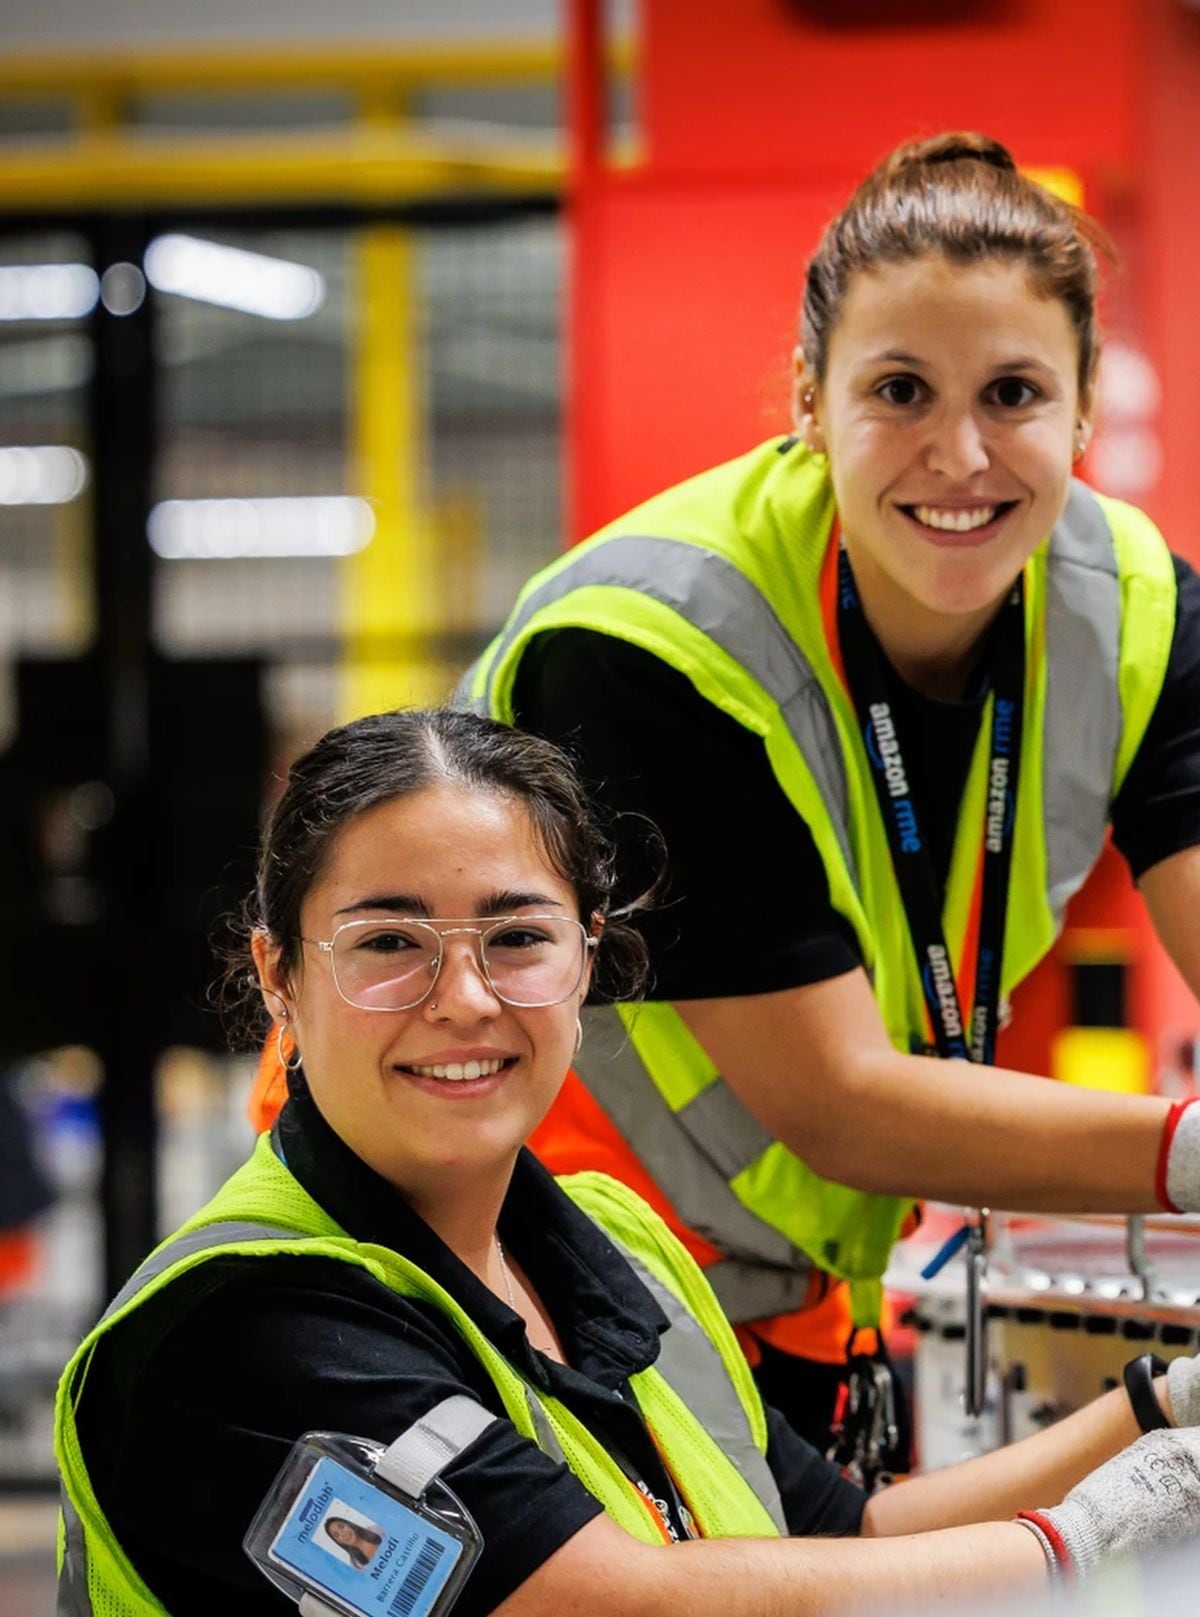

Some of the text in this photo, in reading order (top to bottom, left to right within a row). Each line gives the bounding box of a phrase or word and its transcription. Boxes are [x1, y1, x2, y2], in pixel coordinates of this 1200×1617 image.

[869, 702, 921, 853] amazon rme
[985, 700, 1014, 854] amazon rme
[927, 944, 962, 1037] amazon
[370, 1536, 399, 1580] Melodi
